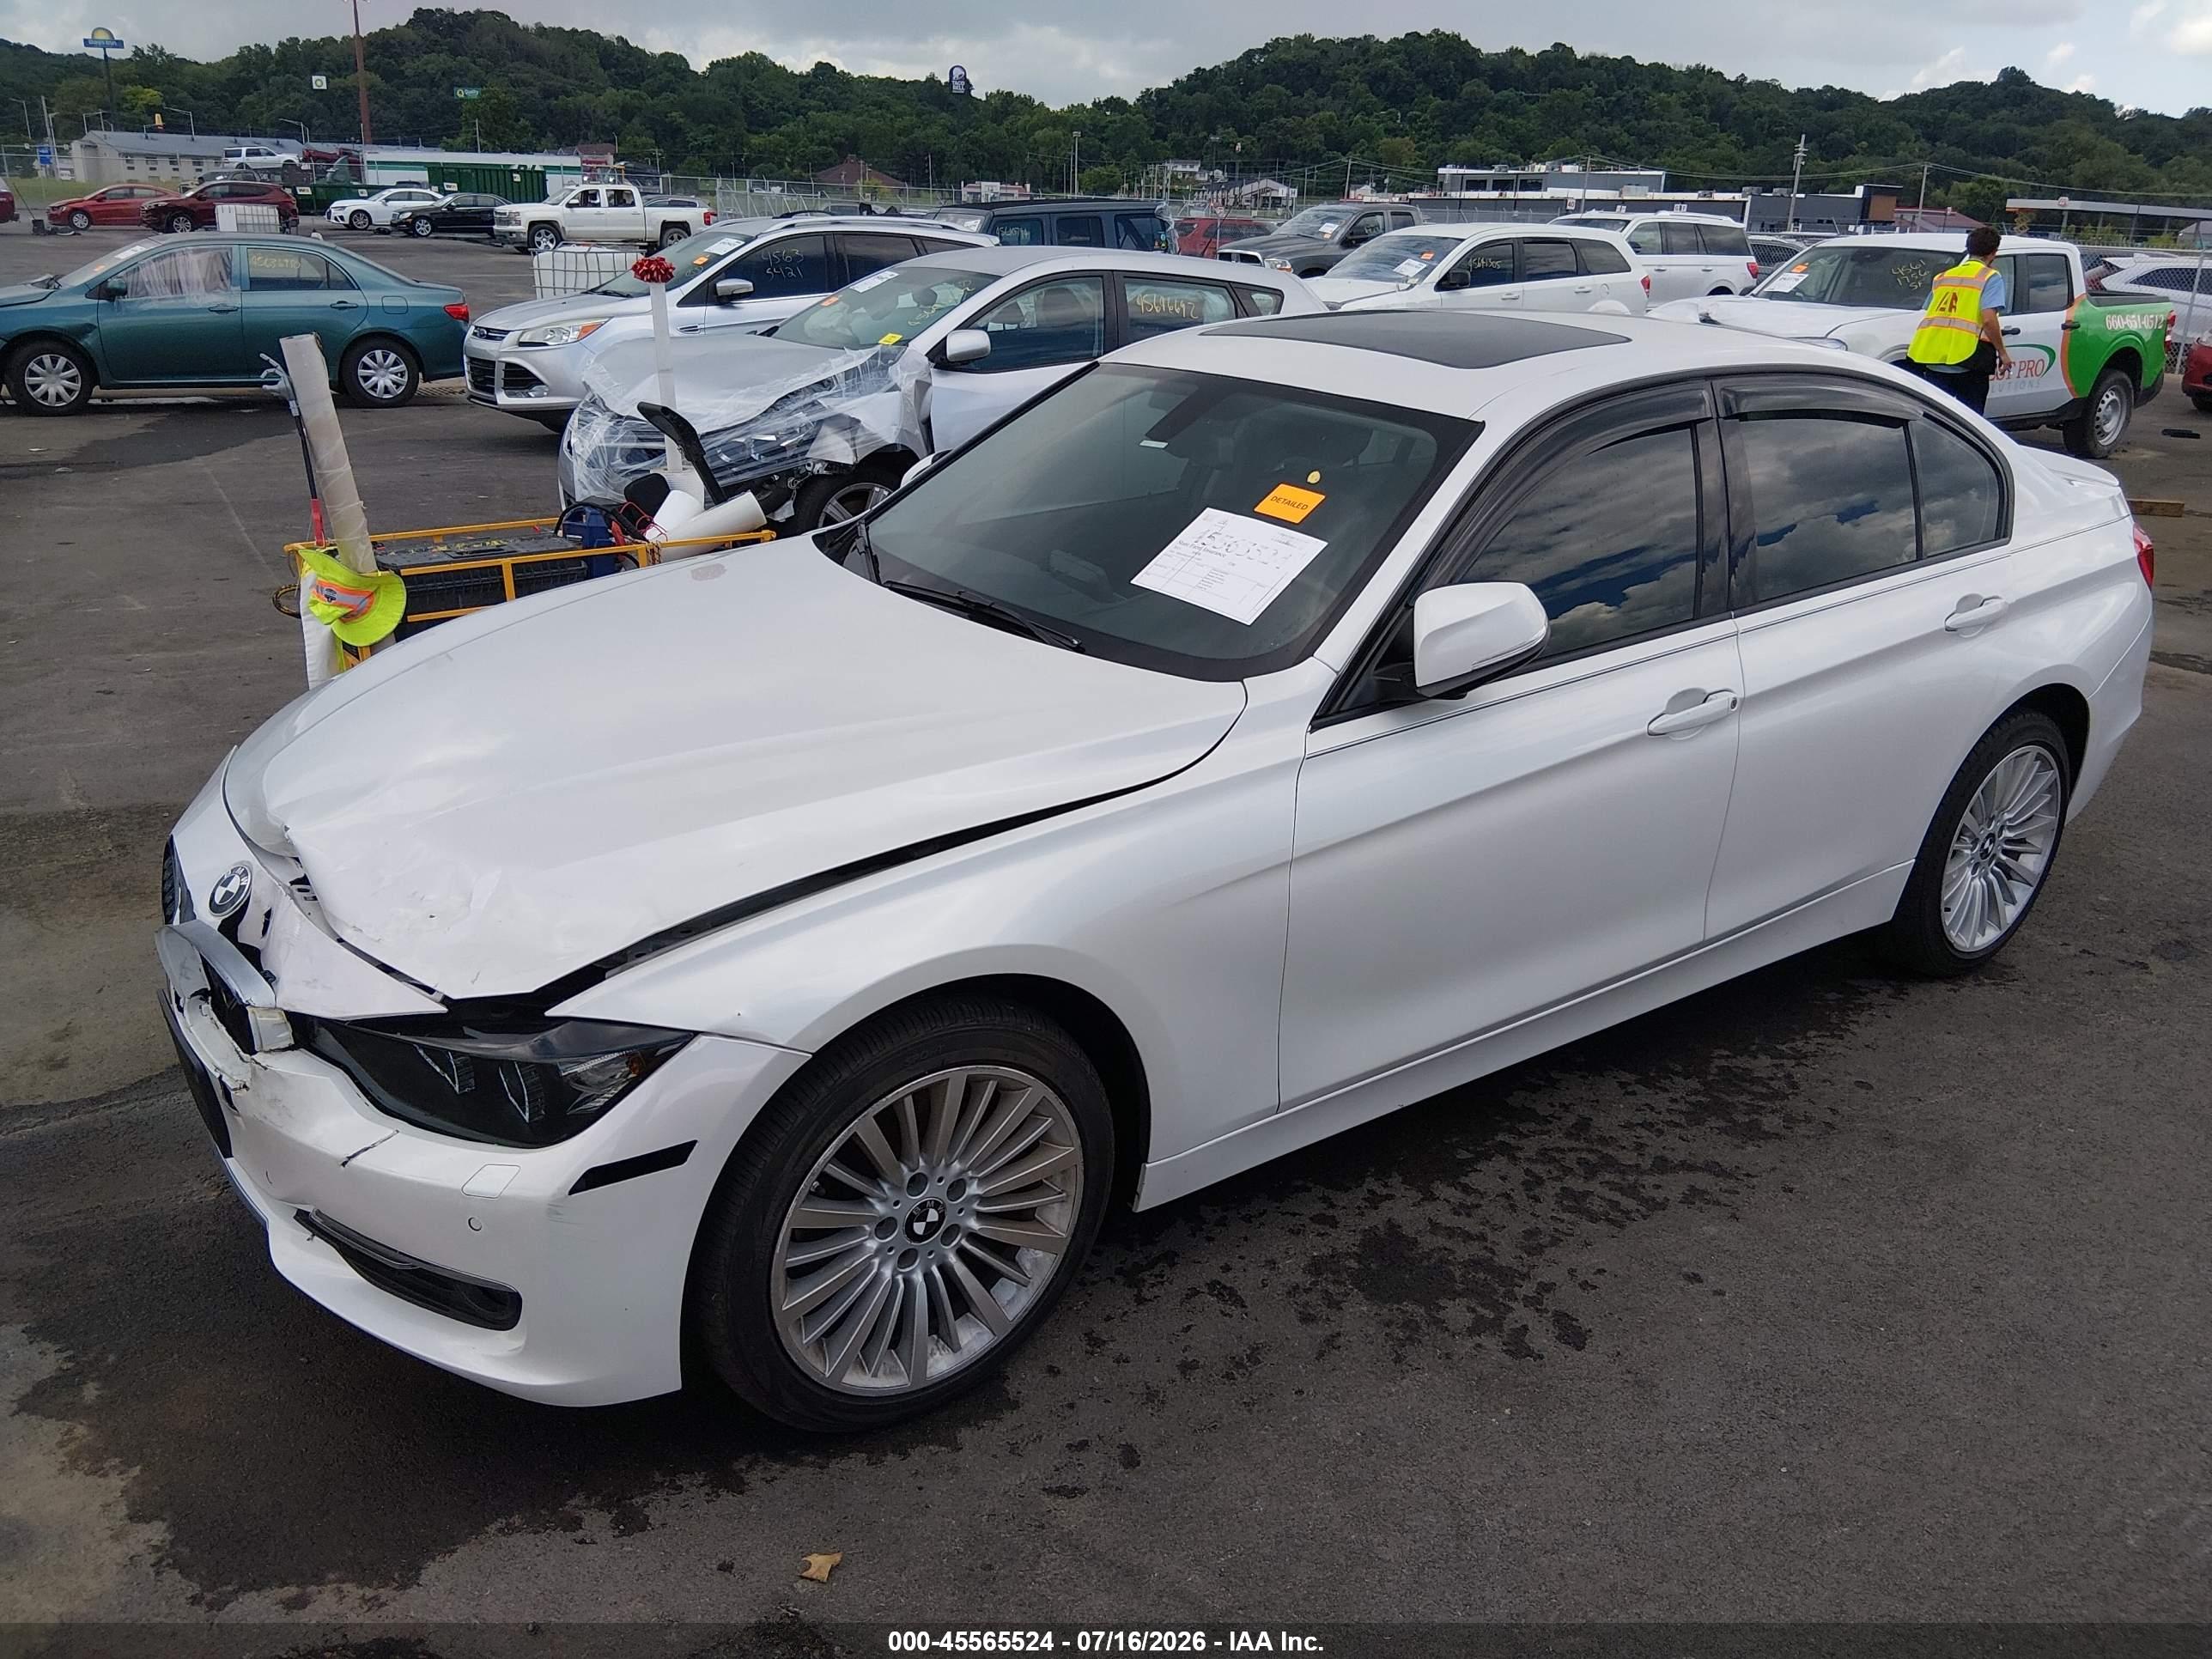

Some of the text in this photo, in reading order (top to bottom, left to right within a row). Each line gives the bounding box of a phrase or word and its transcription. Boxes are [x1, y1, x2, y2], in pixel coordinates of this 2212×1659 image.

[1891, 259, 1926, 276] 4561
[2106, 313, 2164, 330] 660-651-0512
[2017, 358, 2045, 378] PRO
[1271, 495, 1309, 510] DETAILED
[912, 1200, 945, 1216] BMW
